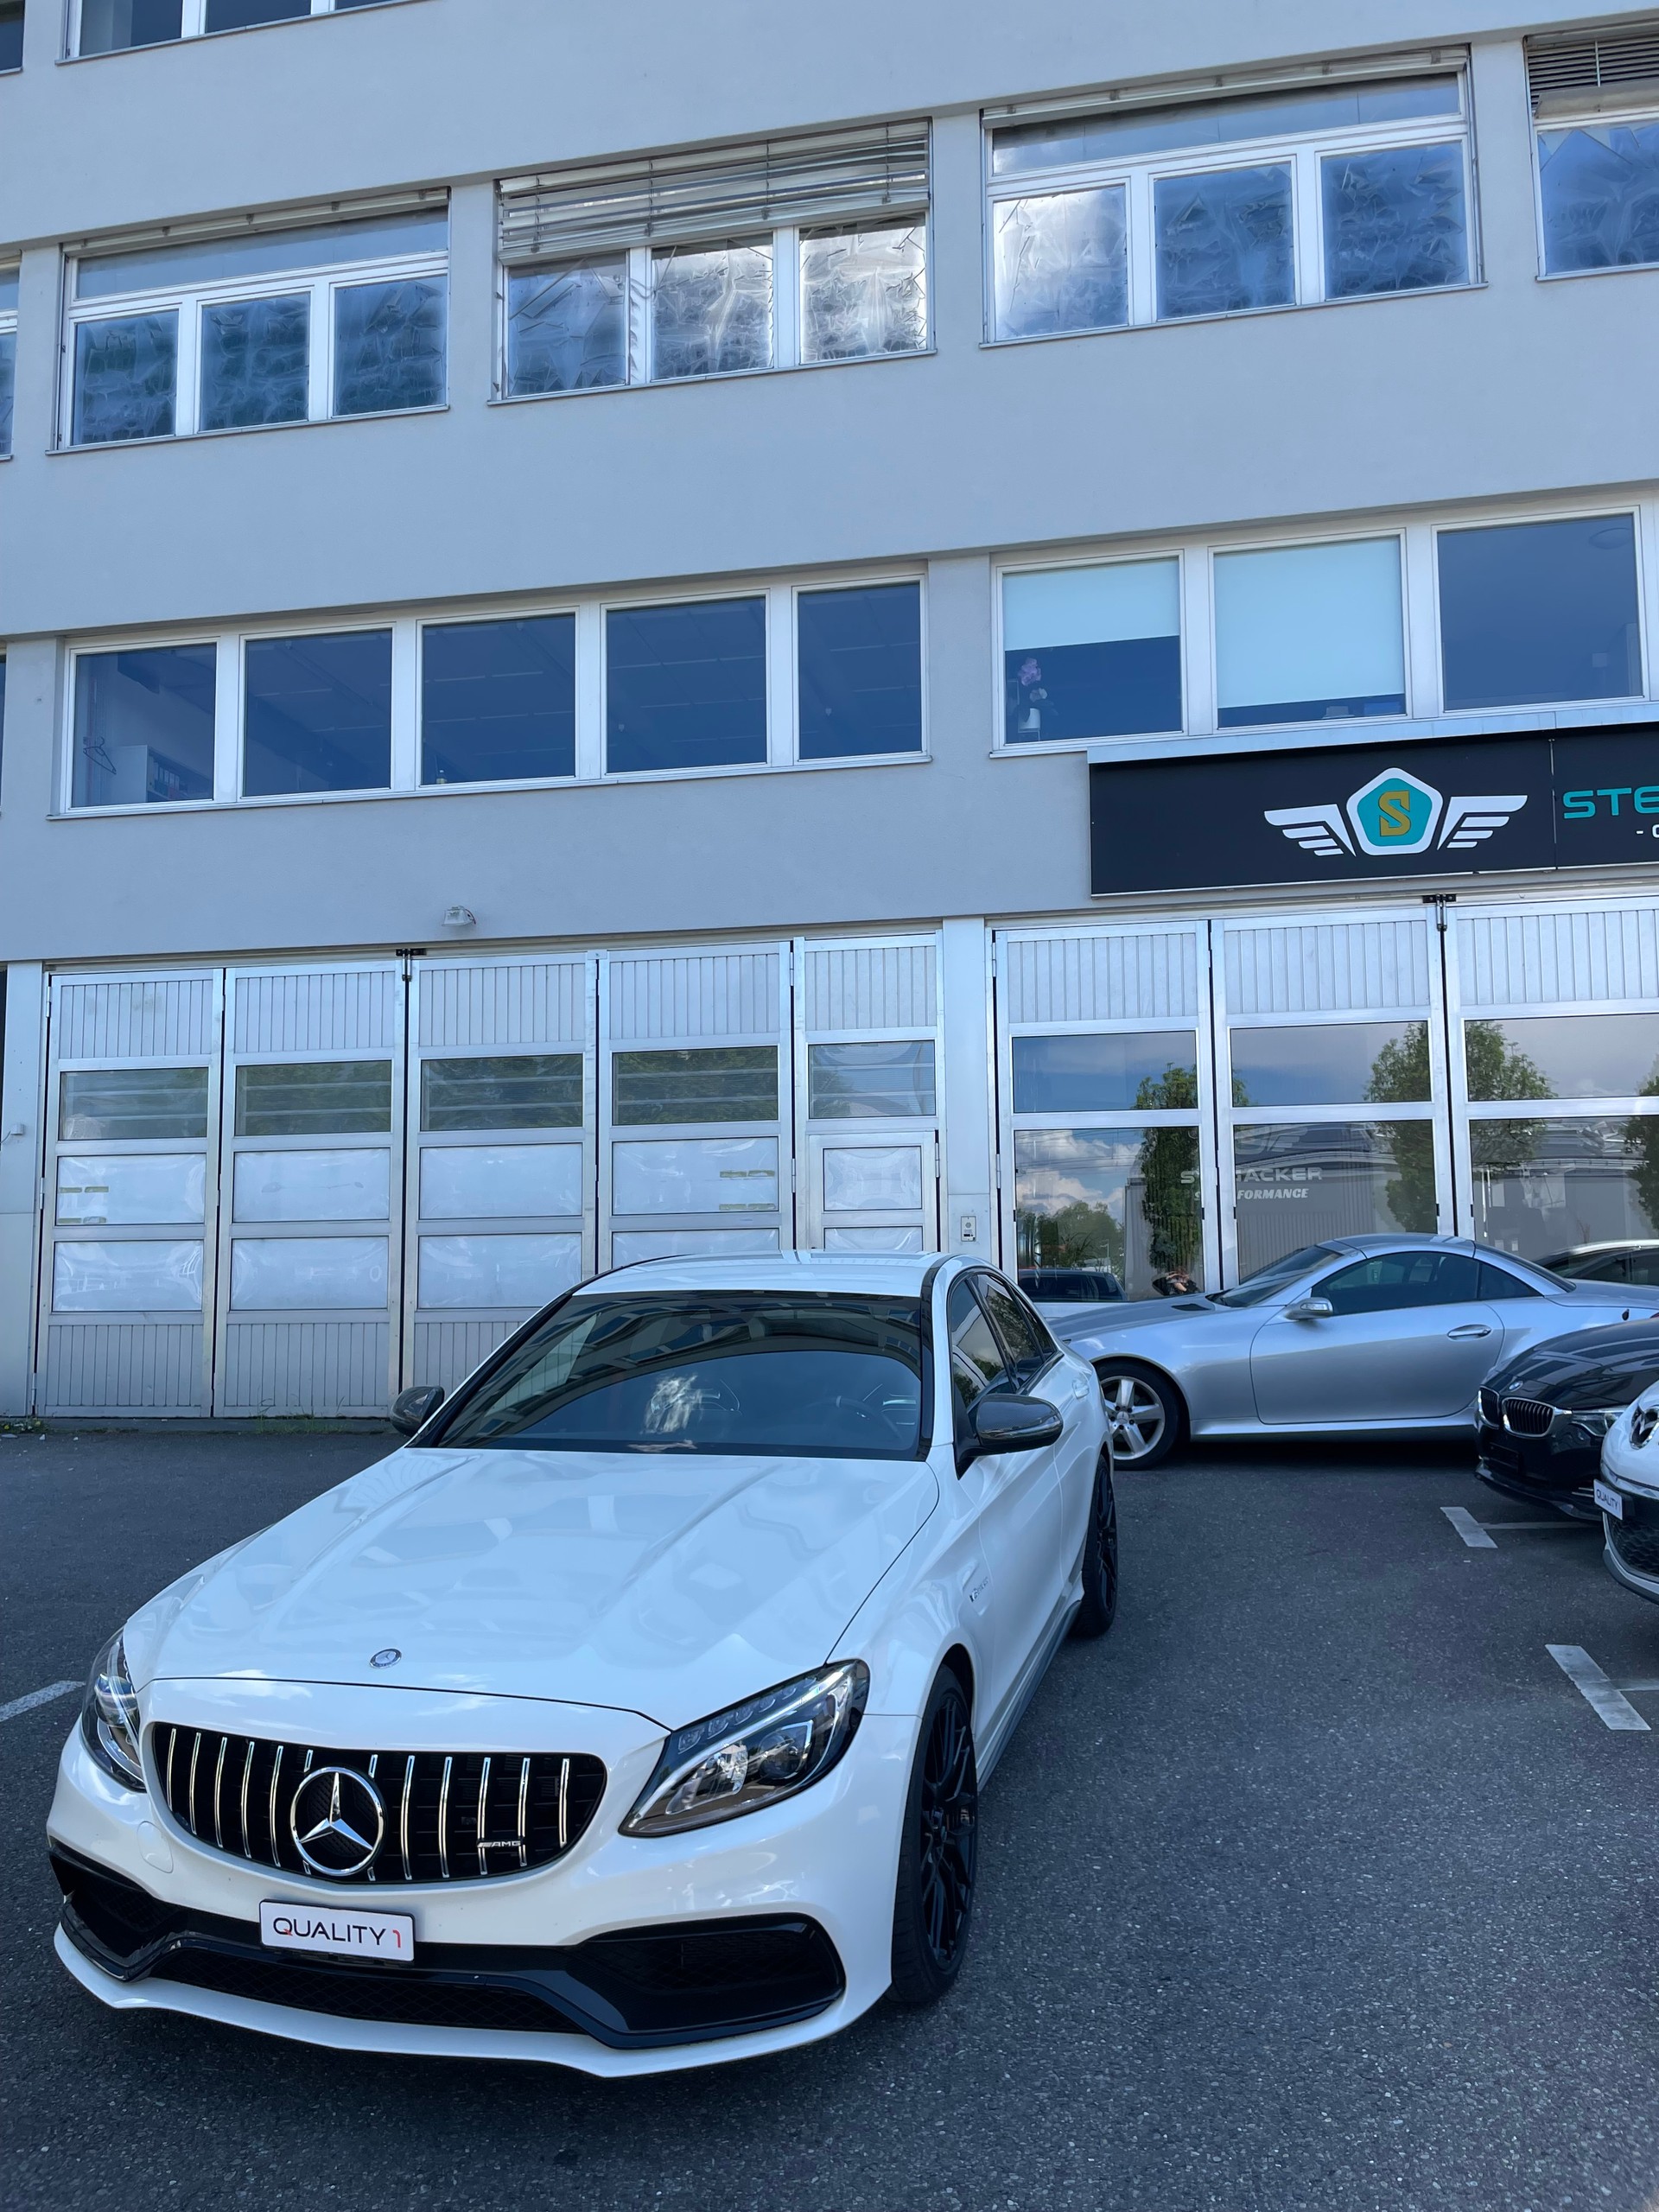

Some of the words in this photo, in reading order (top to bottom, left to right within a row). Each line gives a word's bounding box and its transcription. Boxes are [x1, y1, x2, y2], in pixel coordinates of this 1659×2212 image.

[1378, 790, 1411, 836] S
[1562, 785, 1659, 819] STE
[1236, 1188, 1309, 1199] FORMANCE
[1596, 1489, 1618, 1510] QUALITY
[273, 1916, 386, 1946] QUALITY
